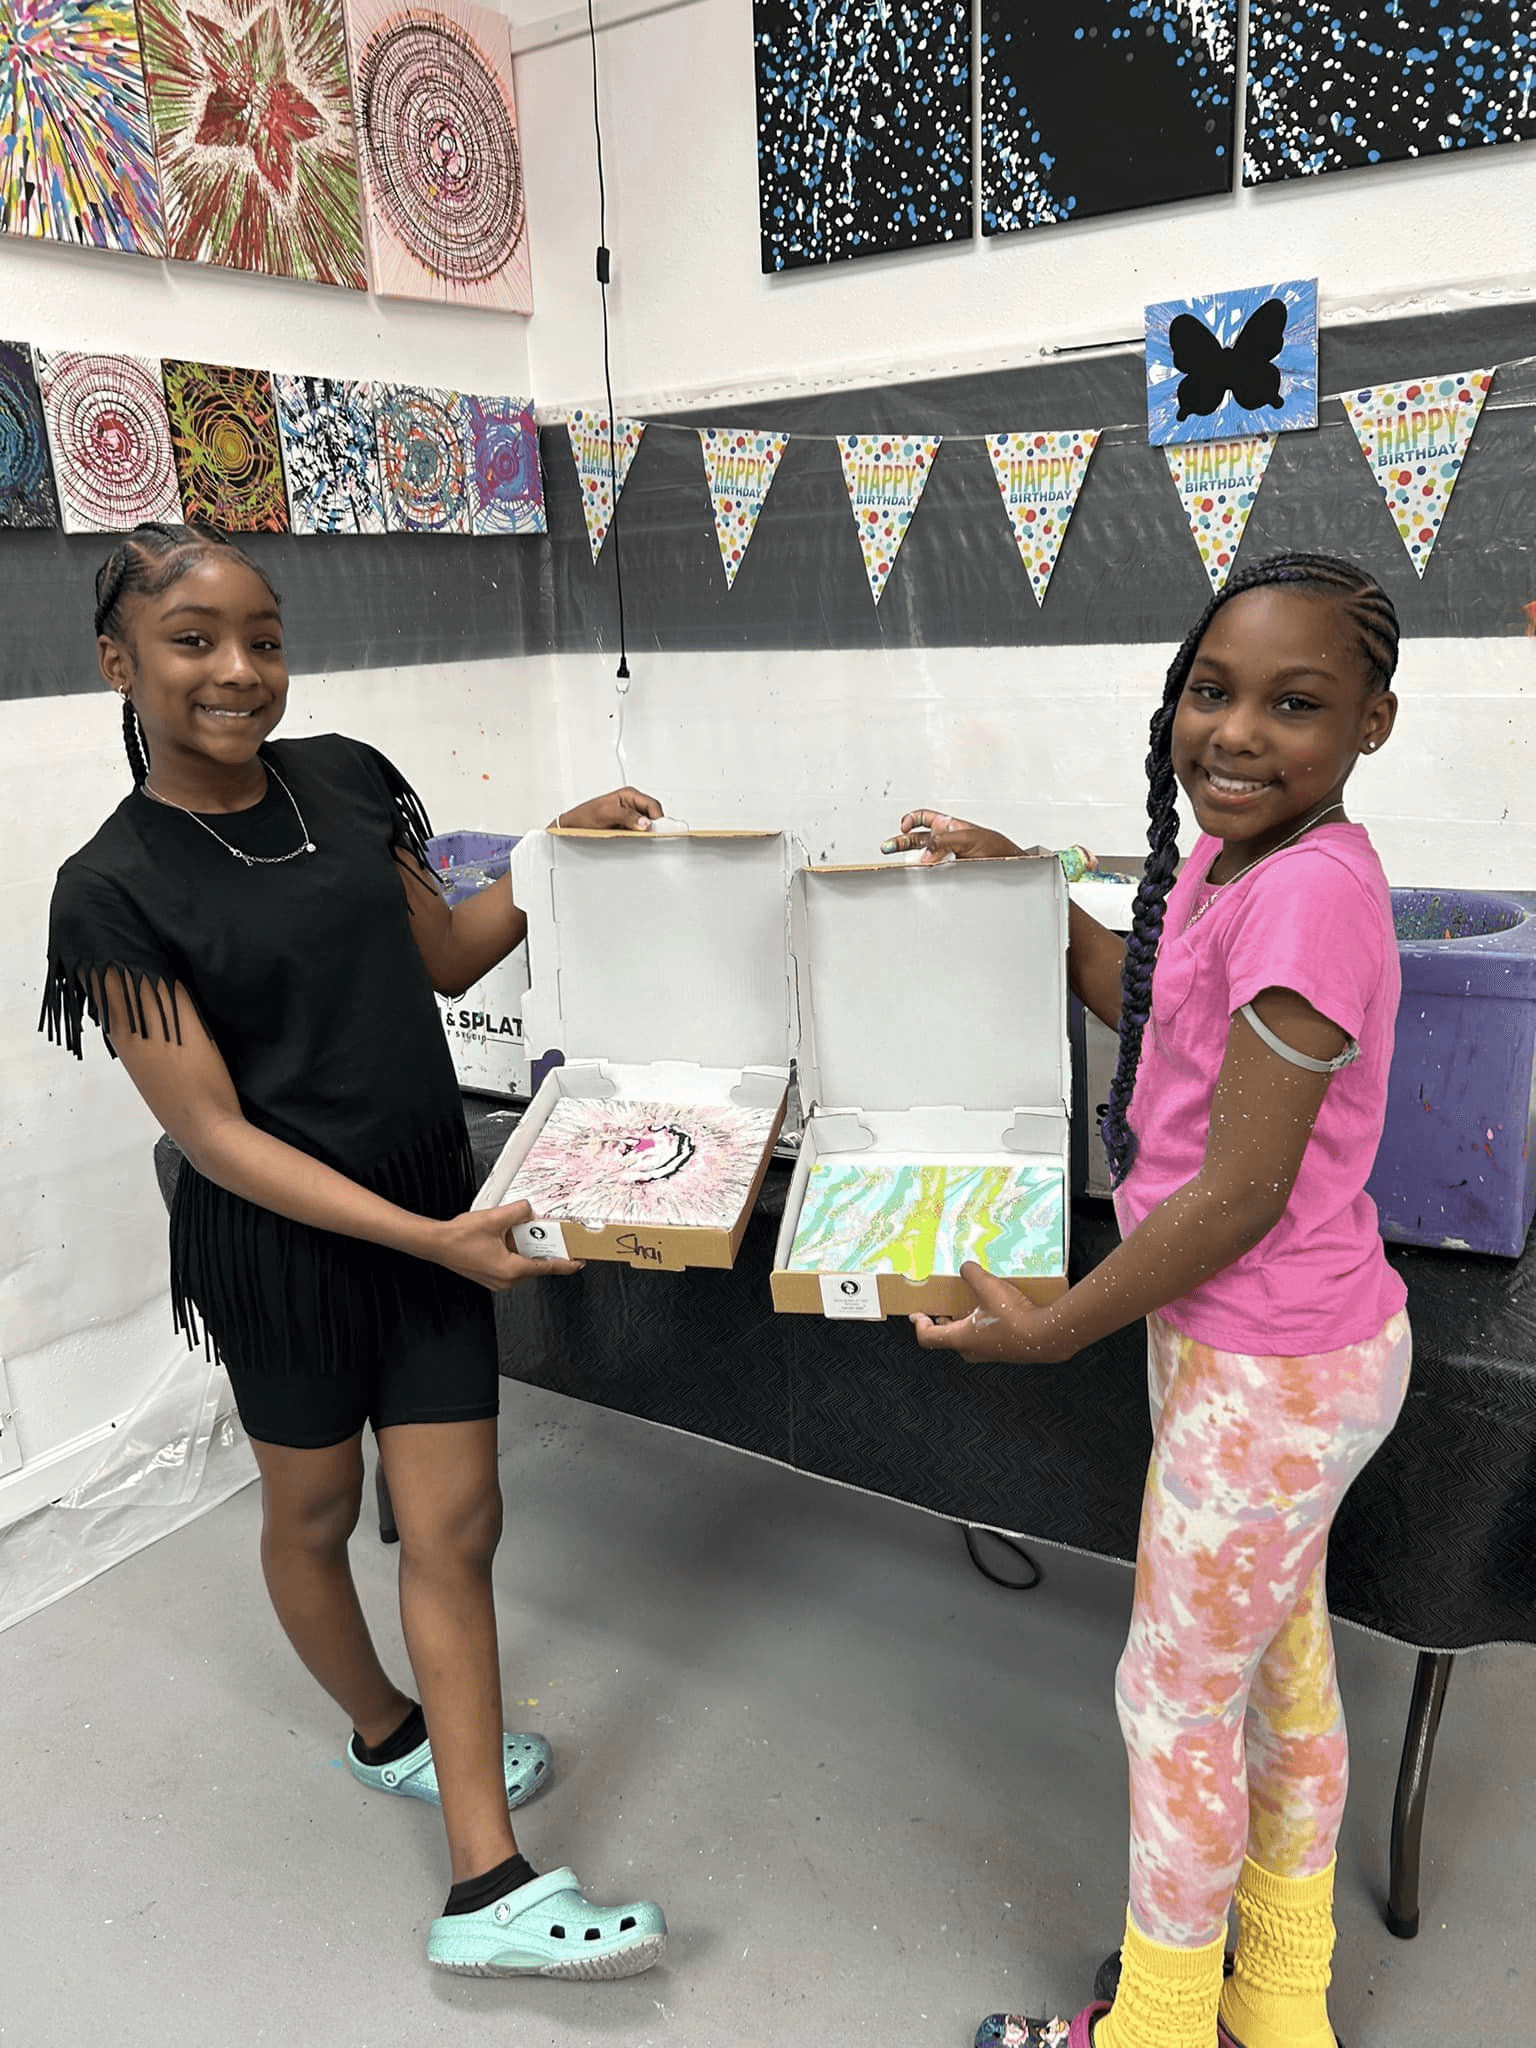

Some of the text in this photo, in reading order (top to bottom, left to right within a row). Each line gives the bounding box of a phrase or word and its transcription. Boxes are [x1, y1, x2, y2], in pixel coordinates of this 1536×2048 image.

[1377, 404, 1459, 455] HAPPY
[1185, 440, 1257, 482] HAPPY
[1378, 442, 1457, 467] BIRTHDAY
[715, 455, 766, 489] HAPPY
[857, 464, 916, 497] HAPPY
[1010, 456, 1074, 493] HAPPY
[1185, 475, 1254, 493] BIRTHDAY
[714, 485, 762, 498] BIRTHDAY
[856, 495, 913, 506] BIRTHDAY
[1010, 490, 1071, 503] BIRTHDAY
[446, 1010, 523, 1037] & SPLAT
[456, 1031, 487, 1041] STUDIO
